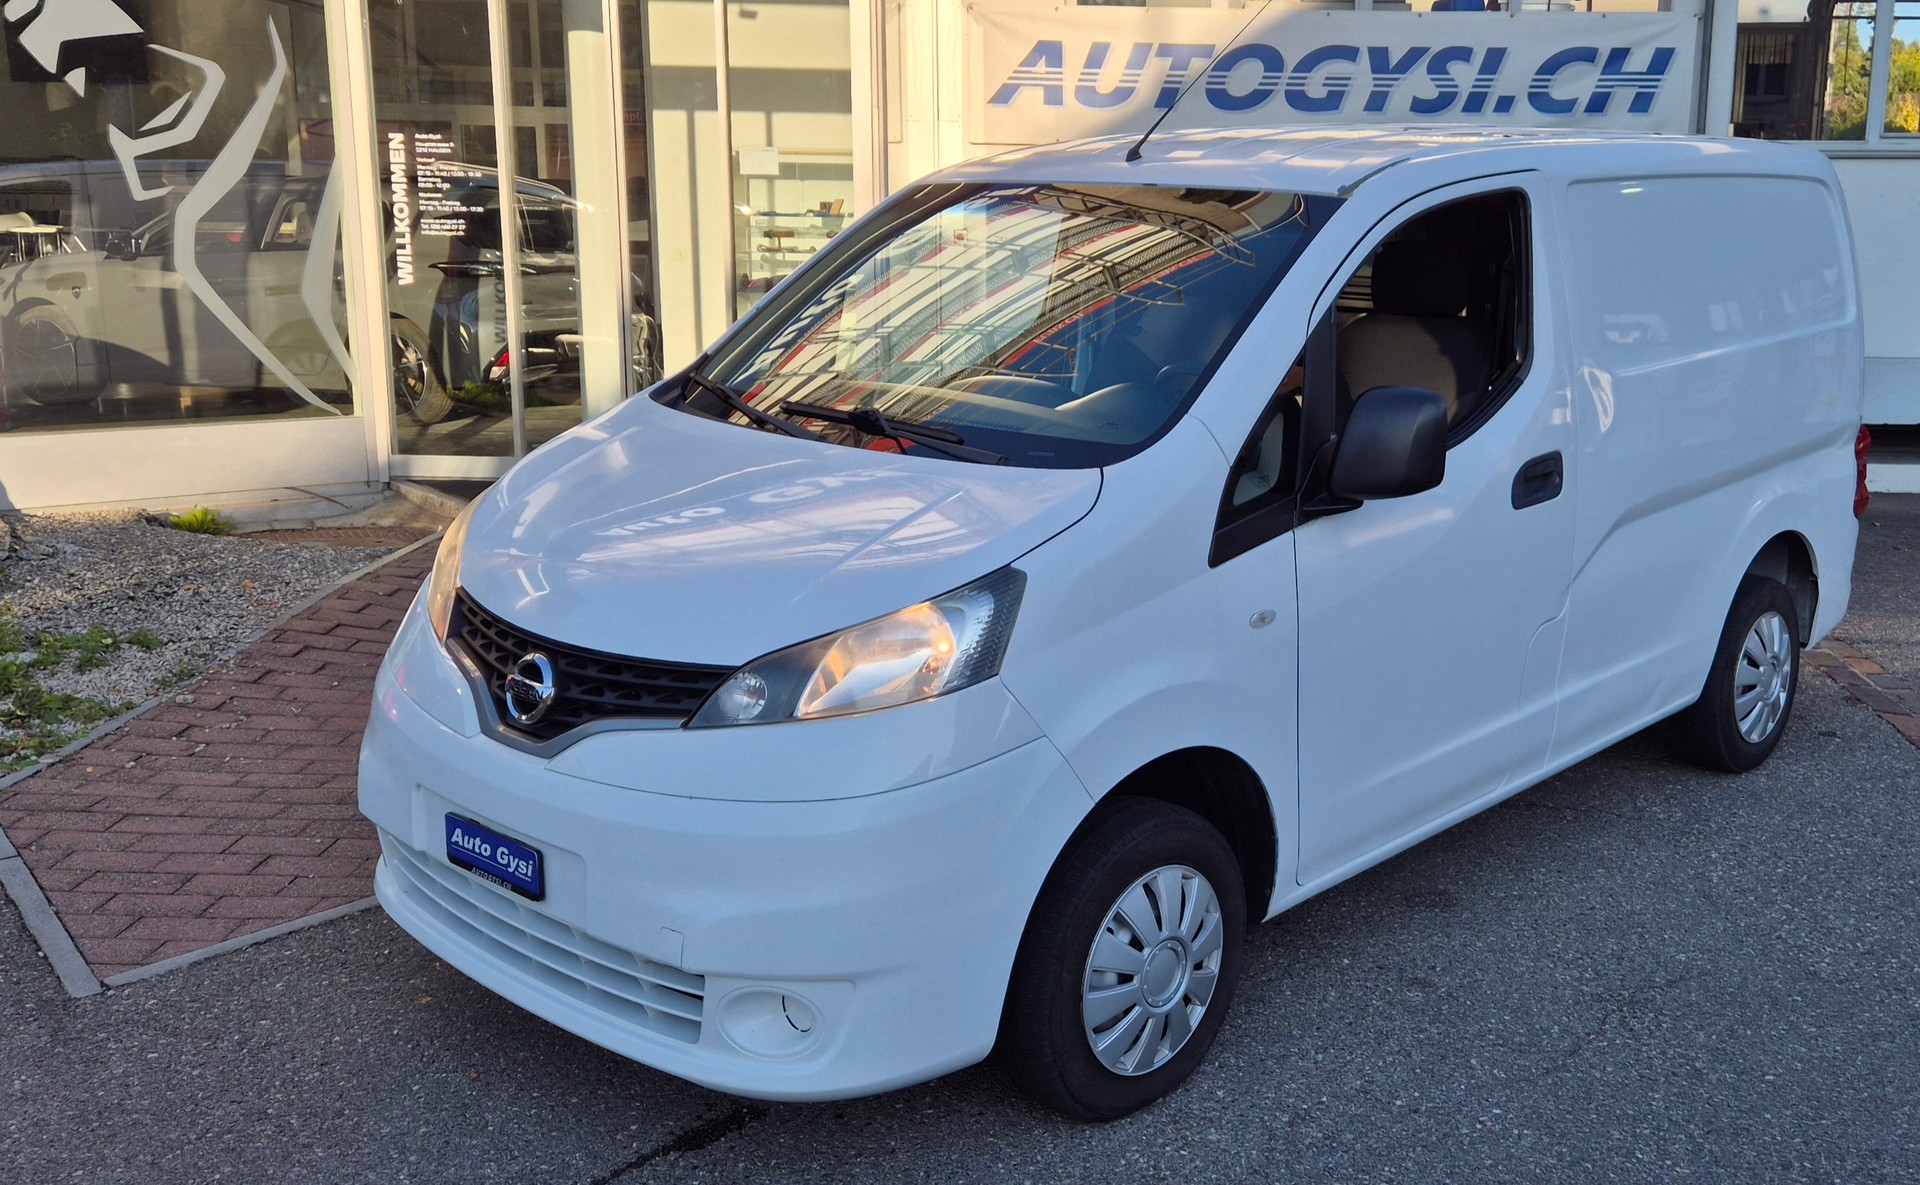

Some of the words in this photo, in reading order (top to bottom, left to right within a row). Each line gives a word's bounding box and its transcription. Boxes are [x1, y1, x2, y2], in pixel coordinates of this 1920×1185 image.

[987, 39, 1677, 115] AUTOGYSI.CH
[388, 132, 414, 285] WILLKOMMEN
[451, 827, 491, 857] Auto
[496, 846, 533, 877] Gysi
[471, 867, 512, 891] AUTOGYSI.CH
